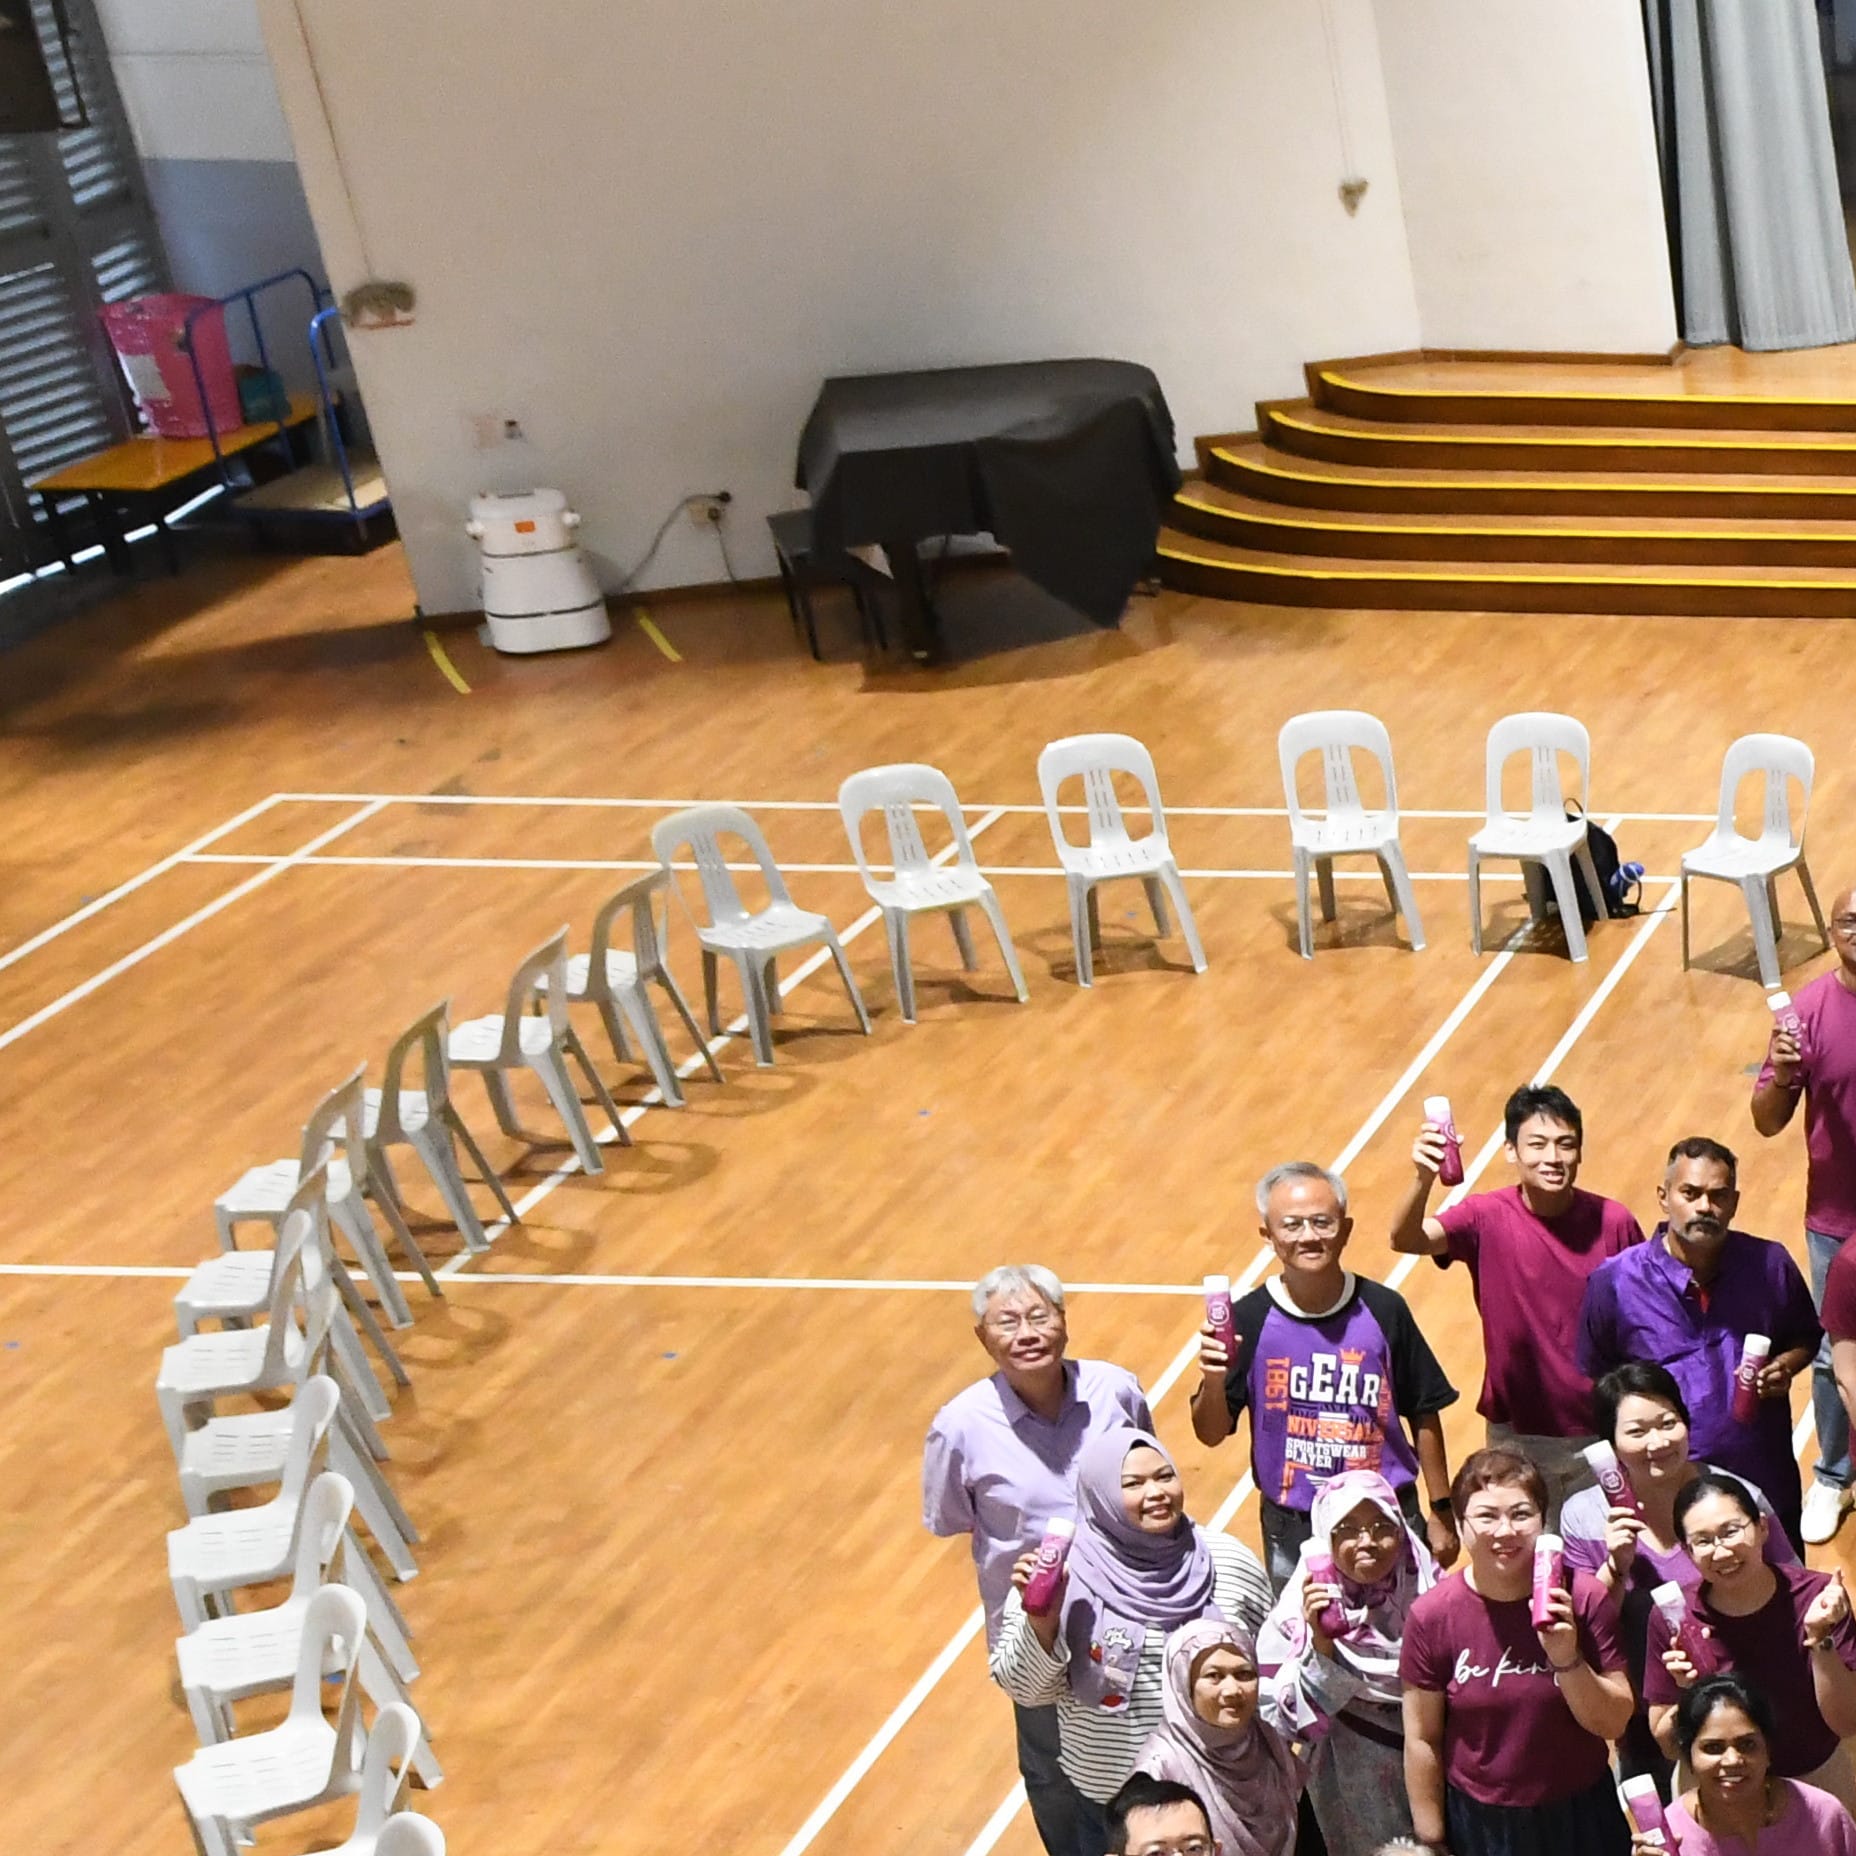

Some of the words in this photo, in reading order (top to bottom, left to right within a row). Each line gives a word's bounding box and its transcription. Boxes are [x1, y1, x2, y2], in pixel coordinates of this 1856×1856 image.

[1264, 1356, 1291, 1412] 1981
[1289, 1352, 1381, 1408] GEAR
[1285, 1449, 1333, 1469] PLAYER
[1286, 1437, 1368, 1459] SPORTSWEAR
[1454, 1647, 1490, 1685] be
